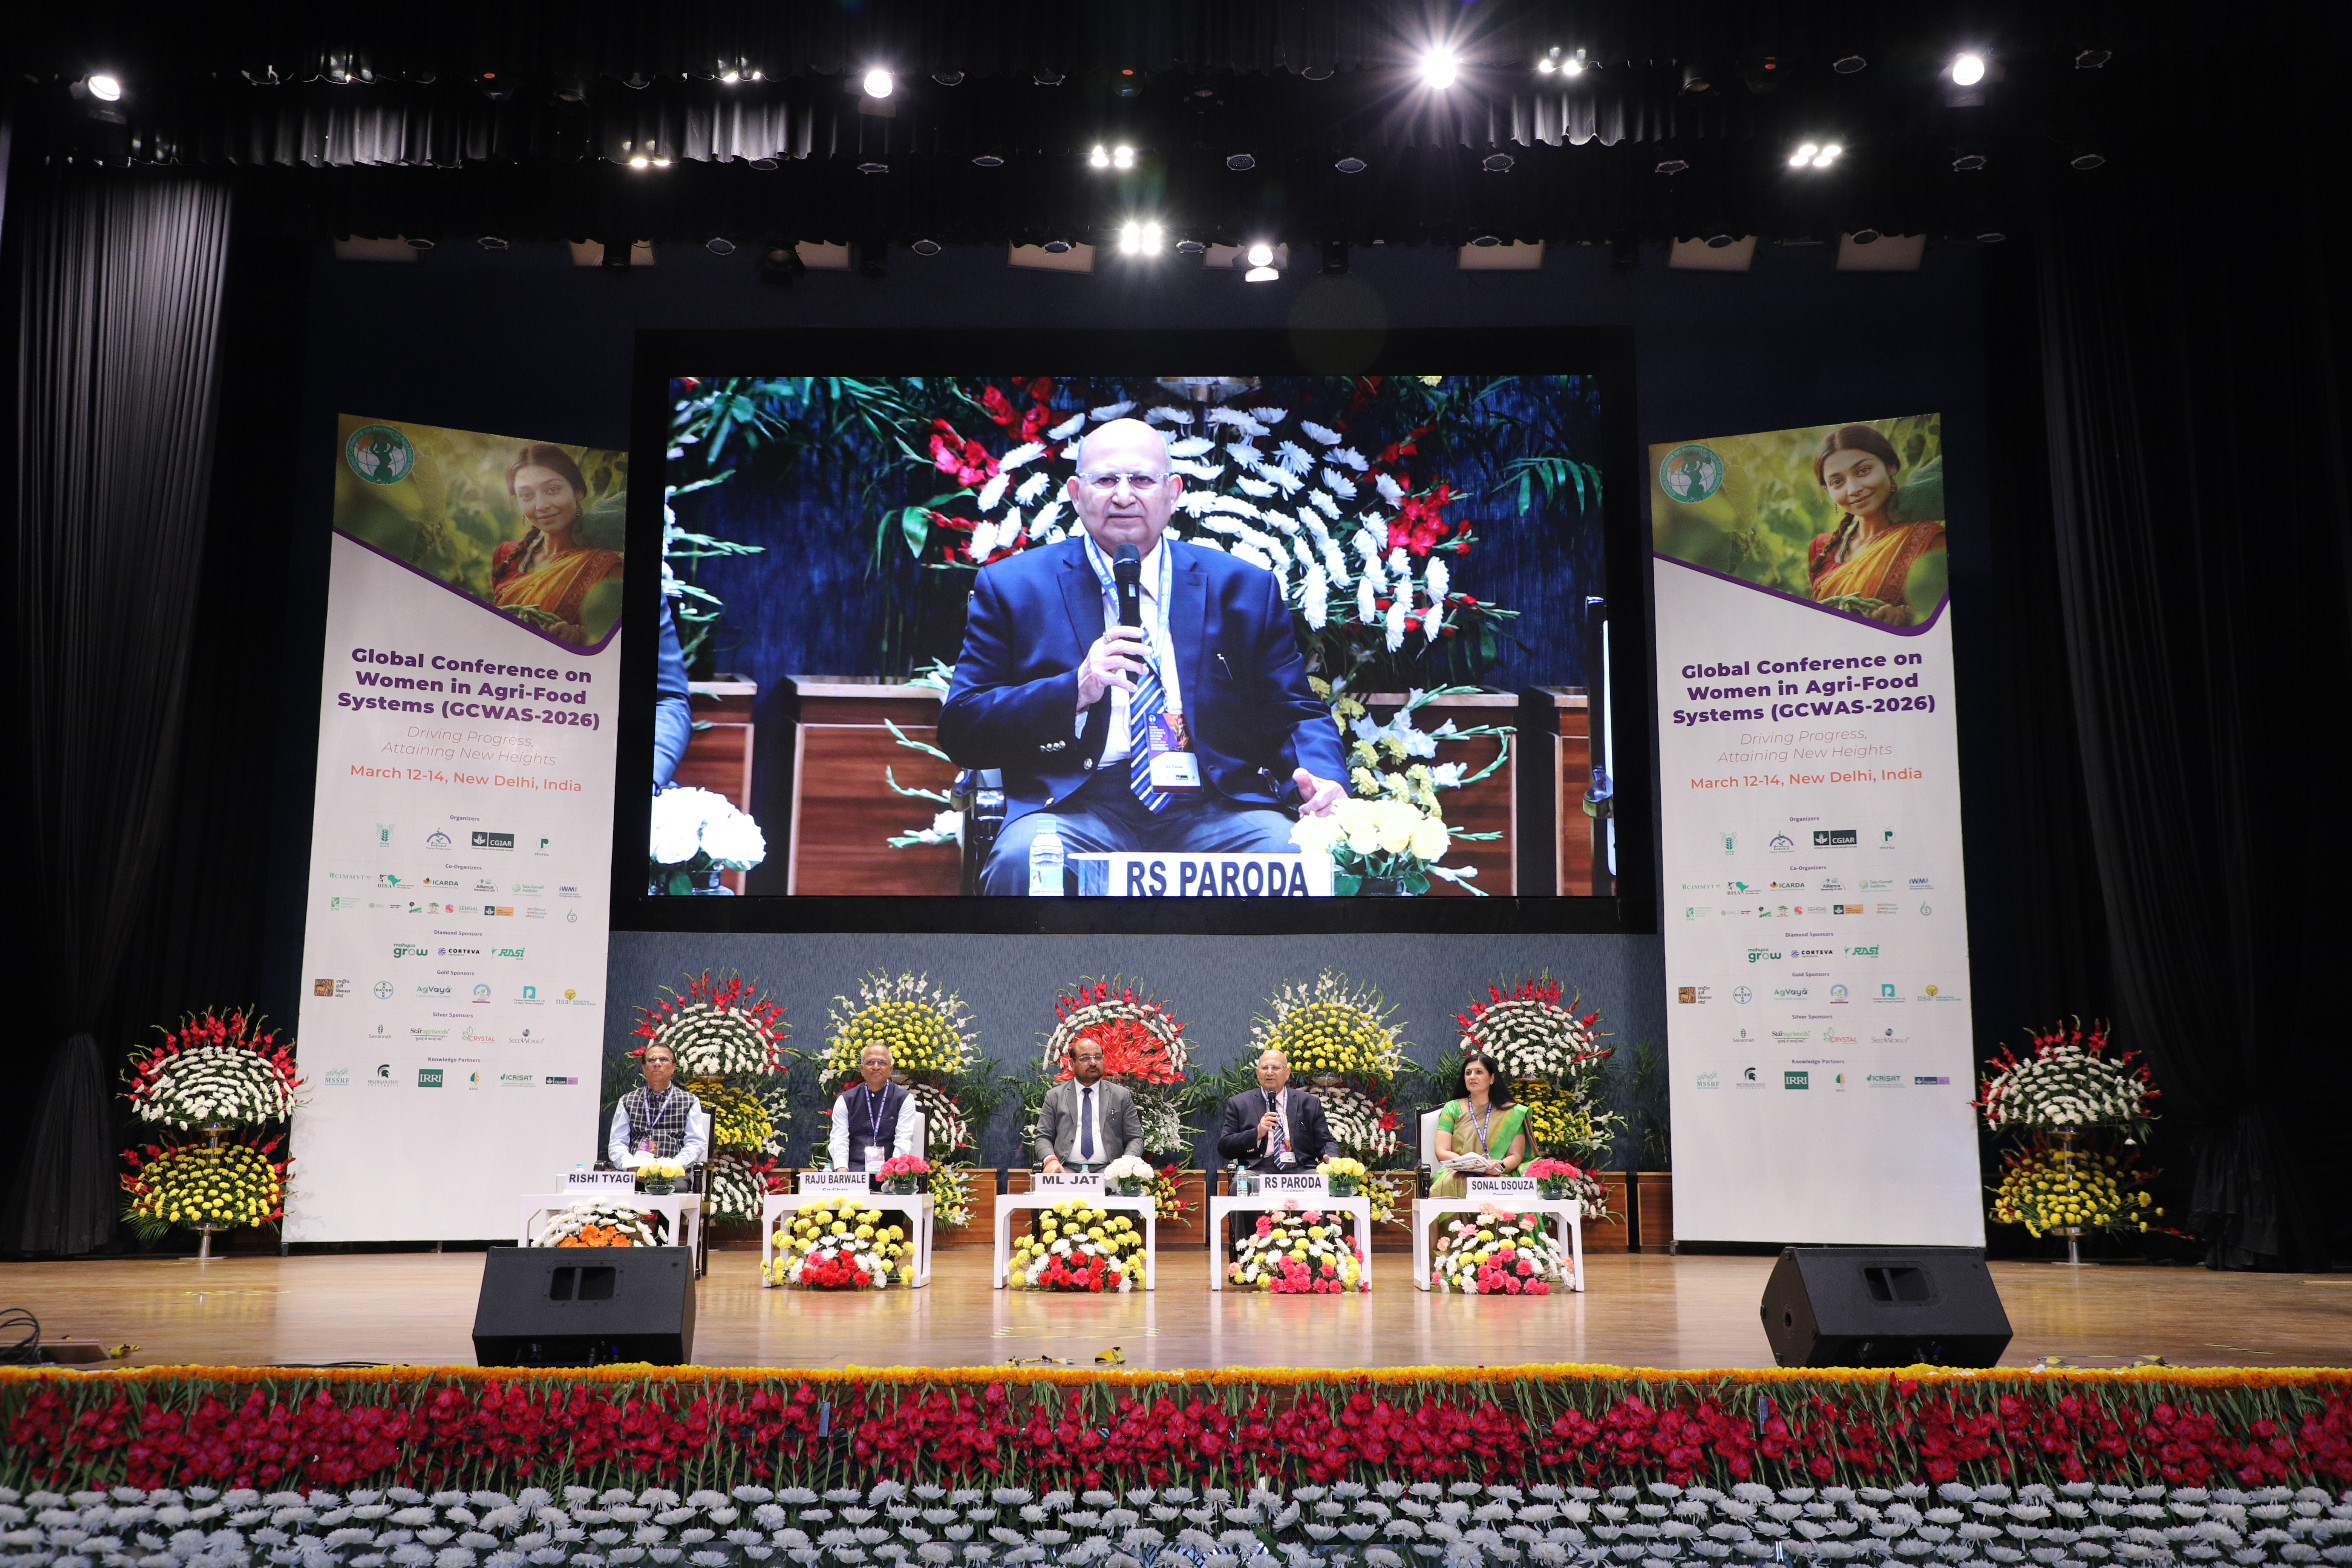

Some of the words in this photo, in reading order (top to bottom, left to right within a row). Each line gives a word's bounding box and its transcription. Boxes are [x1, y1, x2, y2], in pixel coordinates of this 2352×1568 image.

[352, 648, 424, 668] Global
[432, 656, 558, 680] Conference
[565, 671, 591, 683] on
[1682, 661, 1749, 678] Global
[1757, 656, 1886, 674] Conference
[1894, 654, 1922, 665] on
[356, 671, 443, 692] Women
[451, 678, 470, 694] in
[478, 683, 586, 704] Agri-Food
[1687, 686, 1770, 700] Women
[1778, 680, 1798, 695] in
[1805, 673, 1918, 696] Agri-Food
[338, 692, 434, 714] Systems
[442, 701, 599, 730] (GCWAS-2026)
[1673, 709, 1764, 726] Systems
[1772, 695, 1935, 721] (GCWAS-2026)
[407, 726, 462, 743] Driving
[467, 731, 533, 747] Progress,
[1741, 734, 1794, 745] Driving
[1799, 730, 1867, 743] Progress,
[381, 742, 455, 760] Attaining
[460, 747, 494, 760] New
[498, 751, 556, 766] Heights
[1718, 752, 1788, 763] Attaining
[1793, 748, 1828, 759] New
[1832, 744, 1892, 759] Heights
[351, 765, 401, 778] March
[407, 769, 448, 784] 12-14,
[454, 772, 489, 784] New
[495, 775, 538, 790] Delhi,
[544, 779, 581, 792] India
[1691, 776, 1738, 789] March
[1743, 775, 1784, 786] 12-14,
[1790, 774, 1824, 784] New
[1830, 769, 1876, 782] Delhi,
[1882, 768, 1922, 780] India
[1127, 861, 1167, 896] RS
[1180, 861, 1308, 896] PARODA
[394, 948, 428, 958] grow
[1748, 952, 1781, 963] grow
[419, 1074, 442, 1083] IRRI
[1785, 1076, 1807, 1085] IRRI
[569, 1174, 598, 1183] RISHI
[602, 1174, 634, 1183] TYAGI
[805, 1175, 826, 1184] RAJU
[828, 1174, 866, 1184] BARWALE
[1042, 1176, 1064, 1184] ML
[1070, 1176, 1099, 1184] JAT
[1265, 1177, 1277, 1188] RS
[1281, 1177, 1321, 1188] PARODA
[1472, 1181, 1499, 1190] SONAL
[1501, 1181, 1534, 1190] DSOUZA
